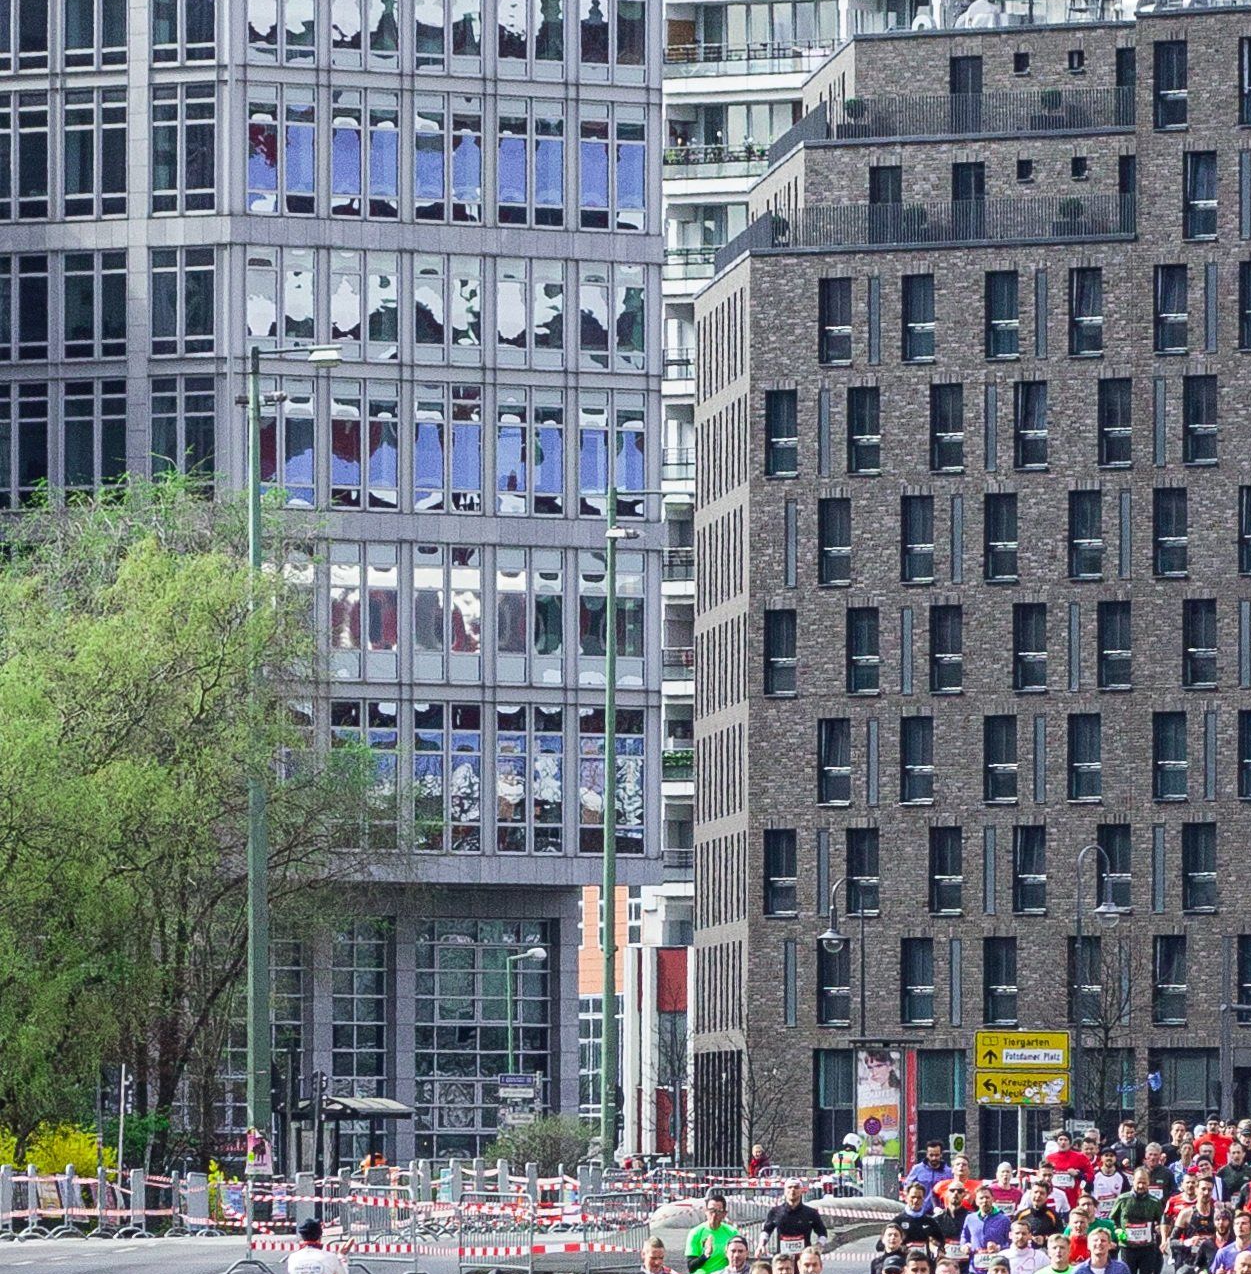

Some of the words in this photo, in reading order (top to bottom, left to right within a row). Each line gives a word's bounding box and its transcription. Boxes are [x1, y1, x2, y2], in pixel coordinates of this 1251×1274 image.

[1003, 1037, 1050, 1048] Tiergarten
[1005, 1052, 1041, 1061] Potsdamer
[1043, 1052, 1060, 1061] Platz
